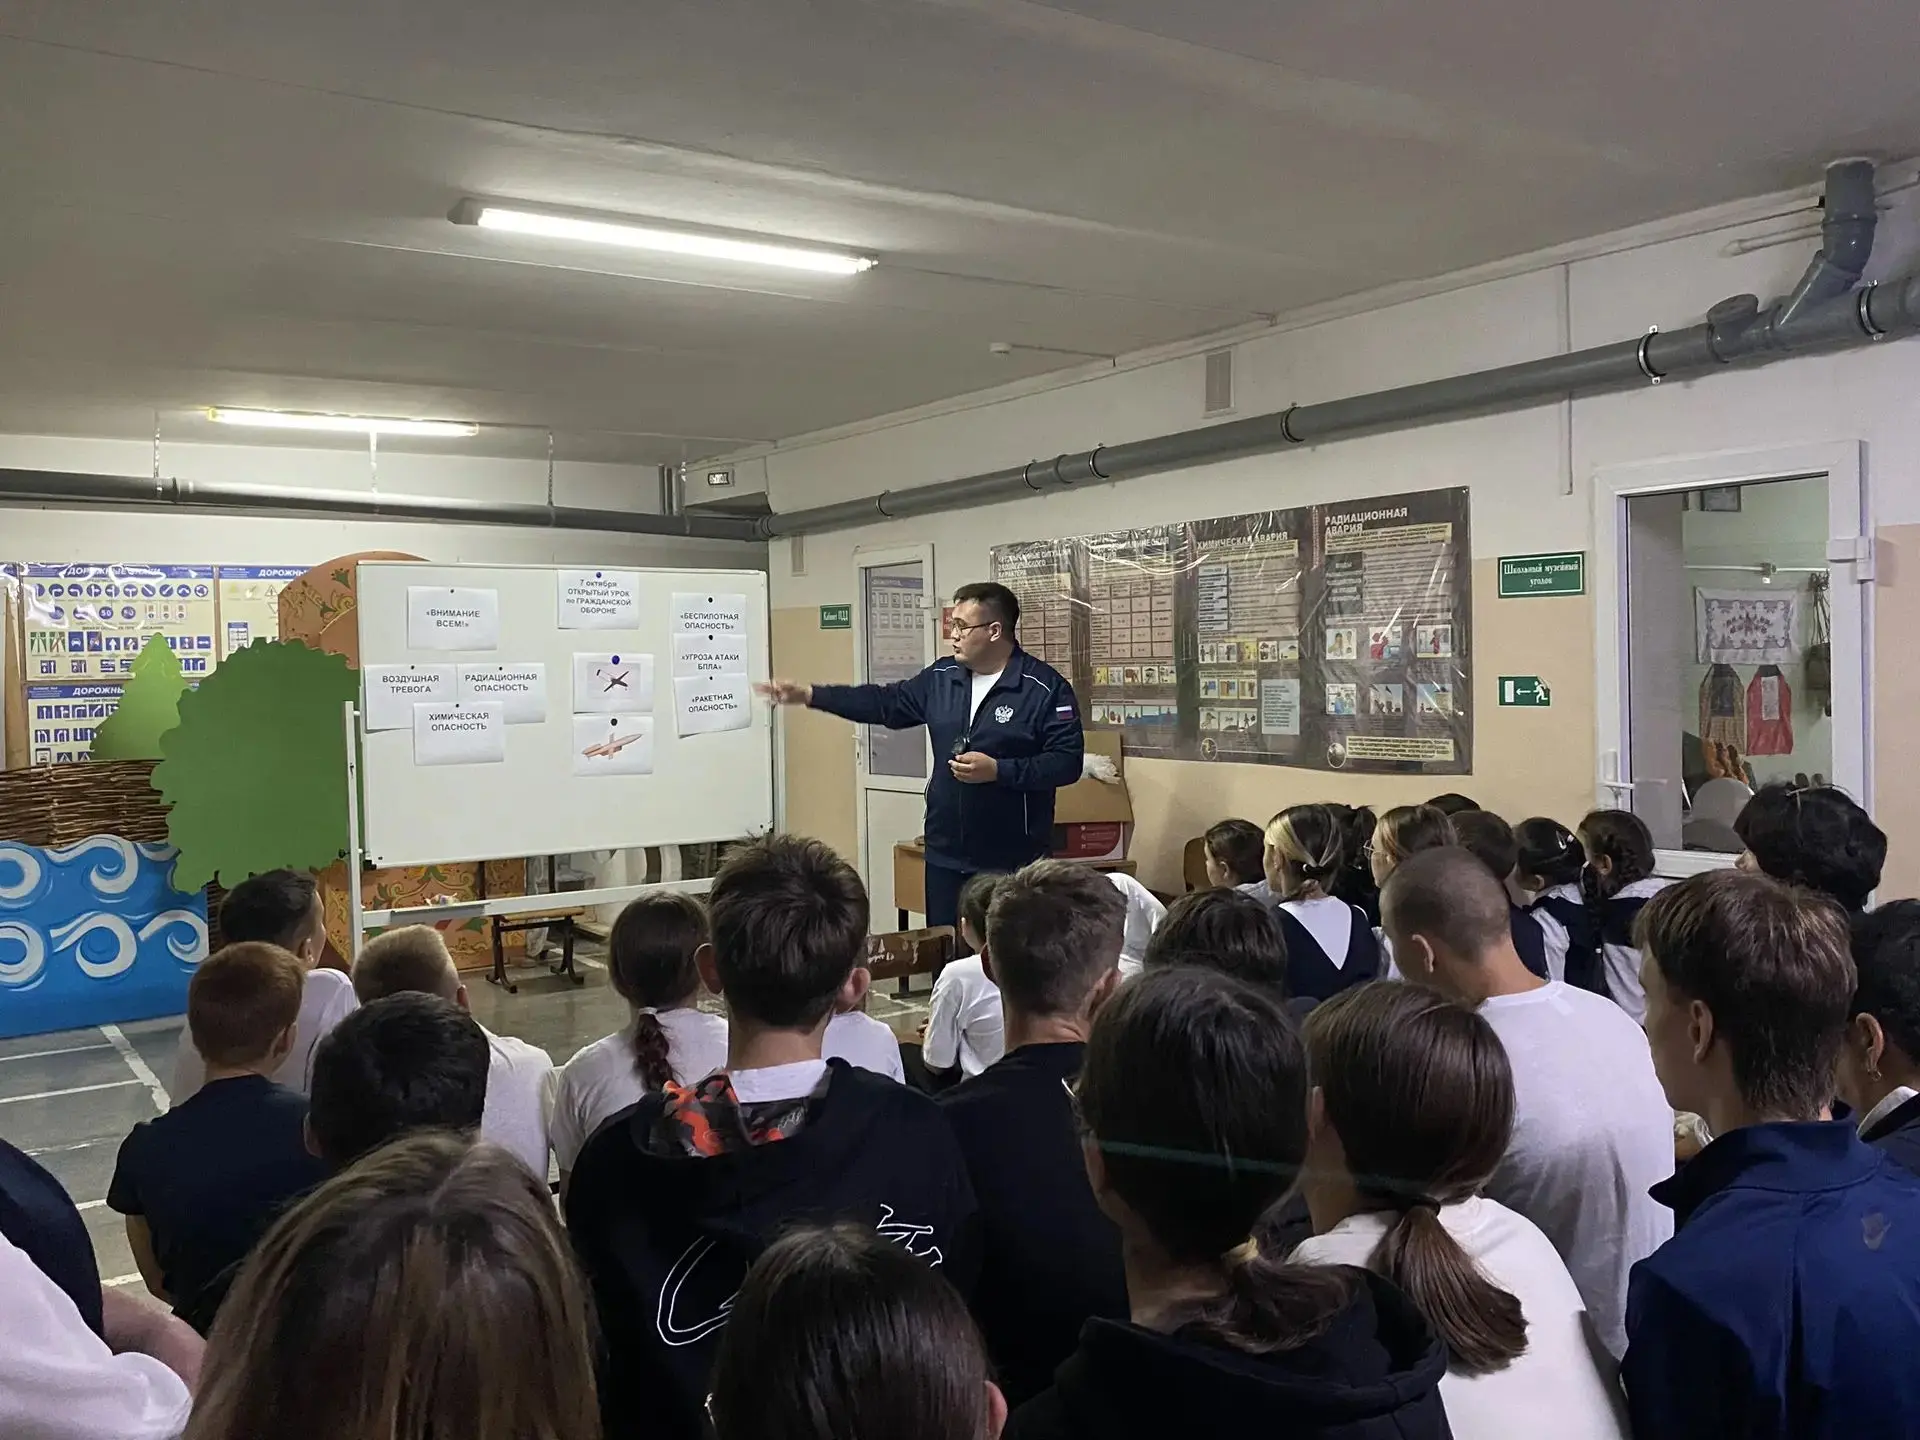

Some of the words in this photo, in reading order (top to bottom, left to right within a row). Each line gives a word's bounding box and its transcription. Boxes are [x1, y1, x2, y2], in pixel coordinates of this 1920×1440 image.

[1325, 507, 1408, 526] РАДИАЦИОННАЯ
[1325, 523, 1363, 537] АВАРИЯ
[1254, 531, 1288, 544] АВАРИЯ
[1503, 563, 1543, 575] Школьный
[1544, 560, 1579, 574] музейный
[1529, 577, 1553, 588] уголок
[567, 588, 609, 596] ОТКРЫТЫЙ
[576, 597, 632, 606] ГРАЖДАНСКОЙ
[426, 608, 480, 618] «ВНИМАНИЕ
[580, 606, 617, 615] ОБОРОНЕ
[680, 612, 739, 621] «БЕСПИЛОТНАЯ
[436, 619, 469, 628] ВСЕМ!»
[684, 622, 734, 631] ОПАСНОСТЬ»
[681, 653, 713, 662] «УГРОЗА
[714, 653, 740, 661] АТАКИ
[698, 663, 722, 671] БПЛА»
[382, 674, 440, 684] ВОЗДУШНАЯ
[465, 673, 537, 682] РАДИАЦИОННАЯ
[391, 685, 431, 694] ТРЕВОГА
[474, 683, 529, 692] ОПАСНОСТЬ
[692, 693, 734, 703] «РАКЕТНАЯ
[688, 703, 738, 713] ОПАСНОСТЬ»
[429, 712, 490, 721] ХИМИЧЕСКАЯ
[431, 722, 487, 731] ОПАСНОСТЬ
